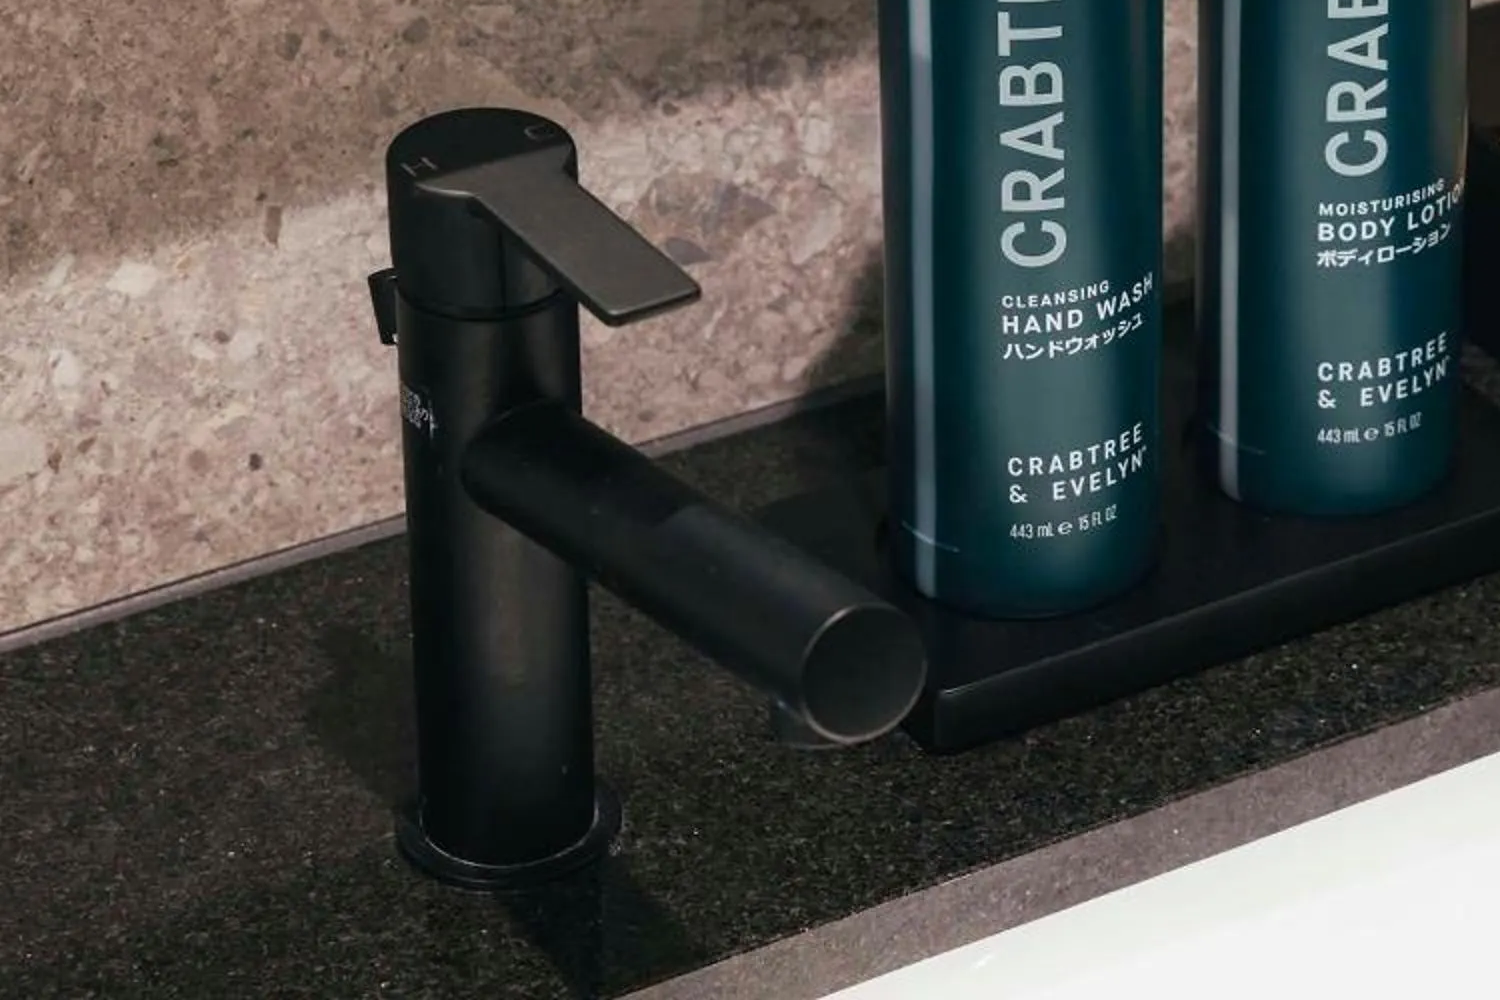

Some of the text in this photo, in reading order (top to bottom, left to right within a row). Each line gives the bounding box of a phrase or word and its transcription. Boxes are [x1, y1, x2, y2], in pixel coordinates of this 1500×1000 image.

[1318, 178, 1445, 217] MOISTURISING
[1316, 223, 1451, 268] ボディローション
[1317, 216, 1395, 242] BODY
[1001, 280, 1110, 308] CLEANSING
[1002, 272, 1153, 334] HAND WASH
[1002, 312, 1143, 360] ハンドウォッシュ
[1317, 331, 1447, 382] CRABTREE
[1317, 389, 1337, 409] &
[1007, 421, 1142, 477] CRABTREE
[1317, 427, 1341, 444] 443
[1009, 483, 1029, 504] &
[1009, 522, 1033, 539] 443
